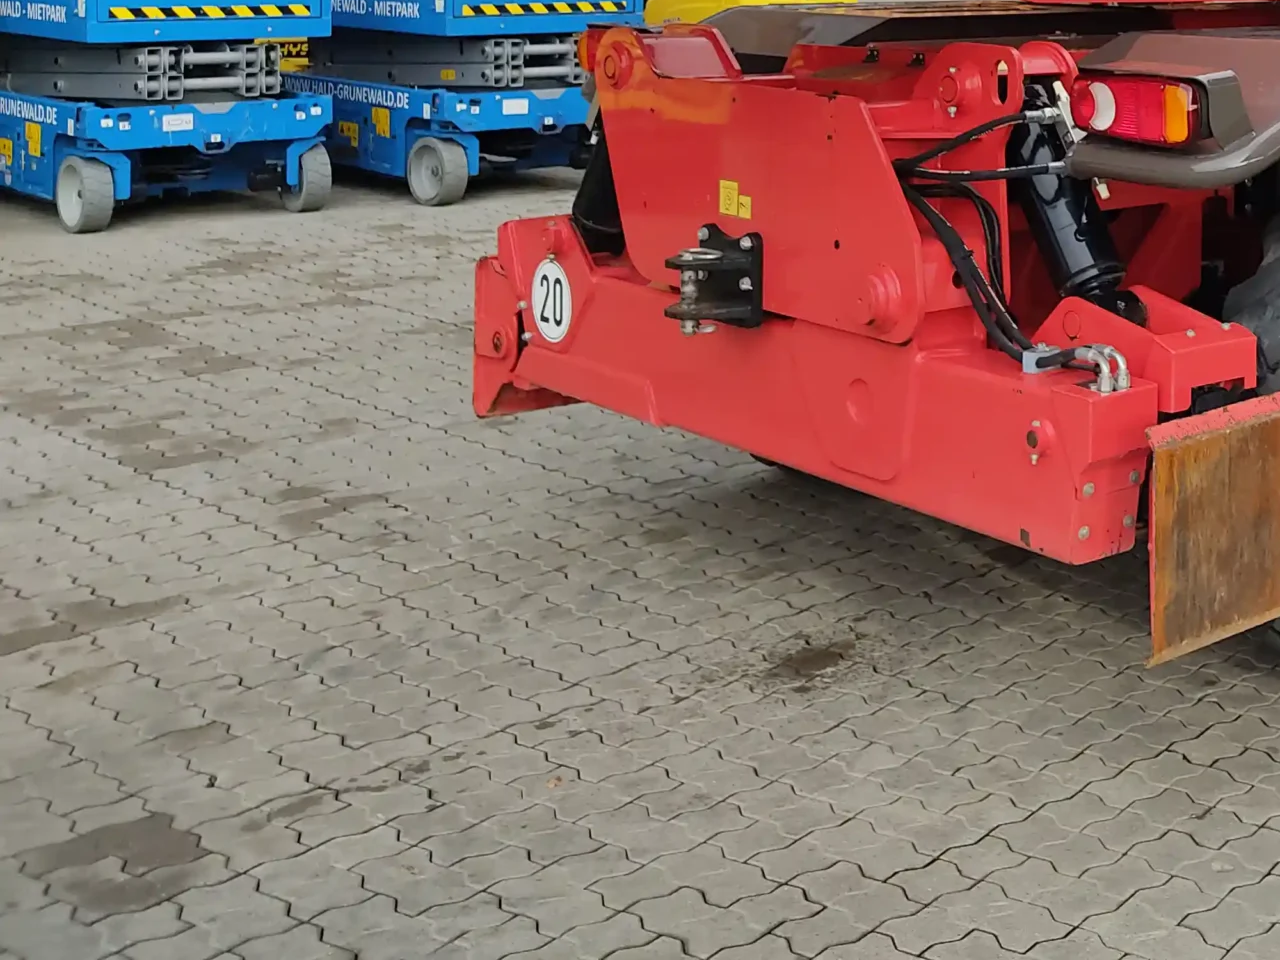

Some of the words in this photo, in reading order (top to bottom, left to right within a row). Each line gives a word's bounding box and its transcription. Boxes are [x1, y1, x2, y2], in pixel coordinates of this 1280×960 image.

[27, 2, 67, 23] MIETPARK
[374, 0, 420, 19] MIETPARK
[284, 76, 410, 109] WWW.HALD-GRUNEWALD.DE
[540, 273, 563, 328] 20
